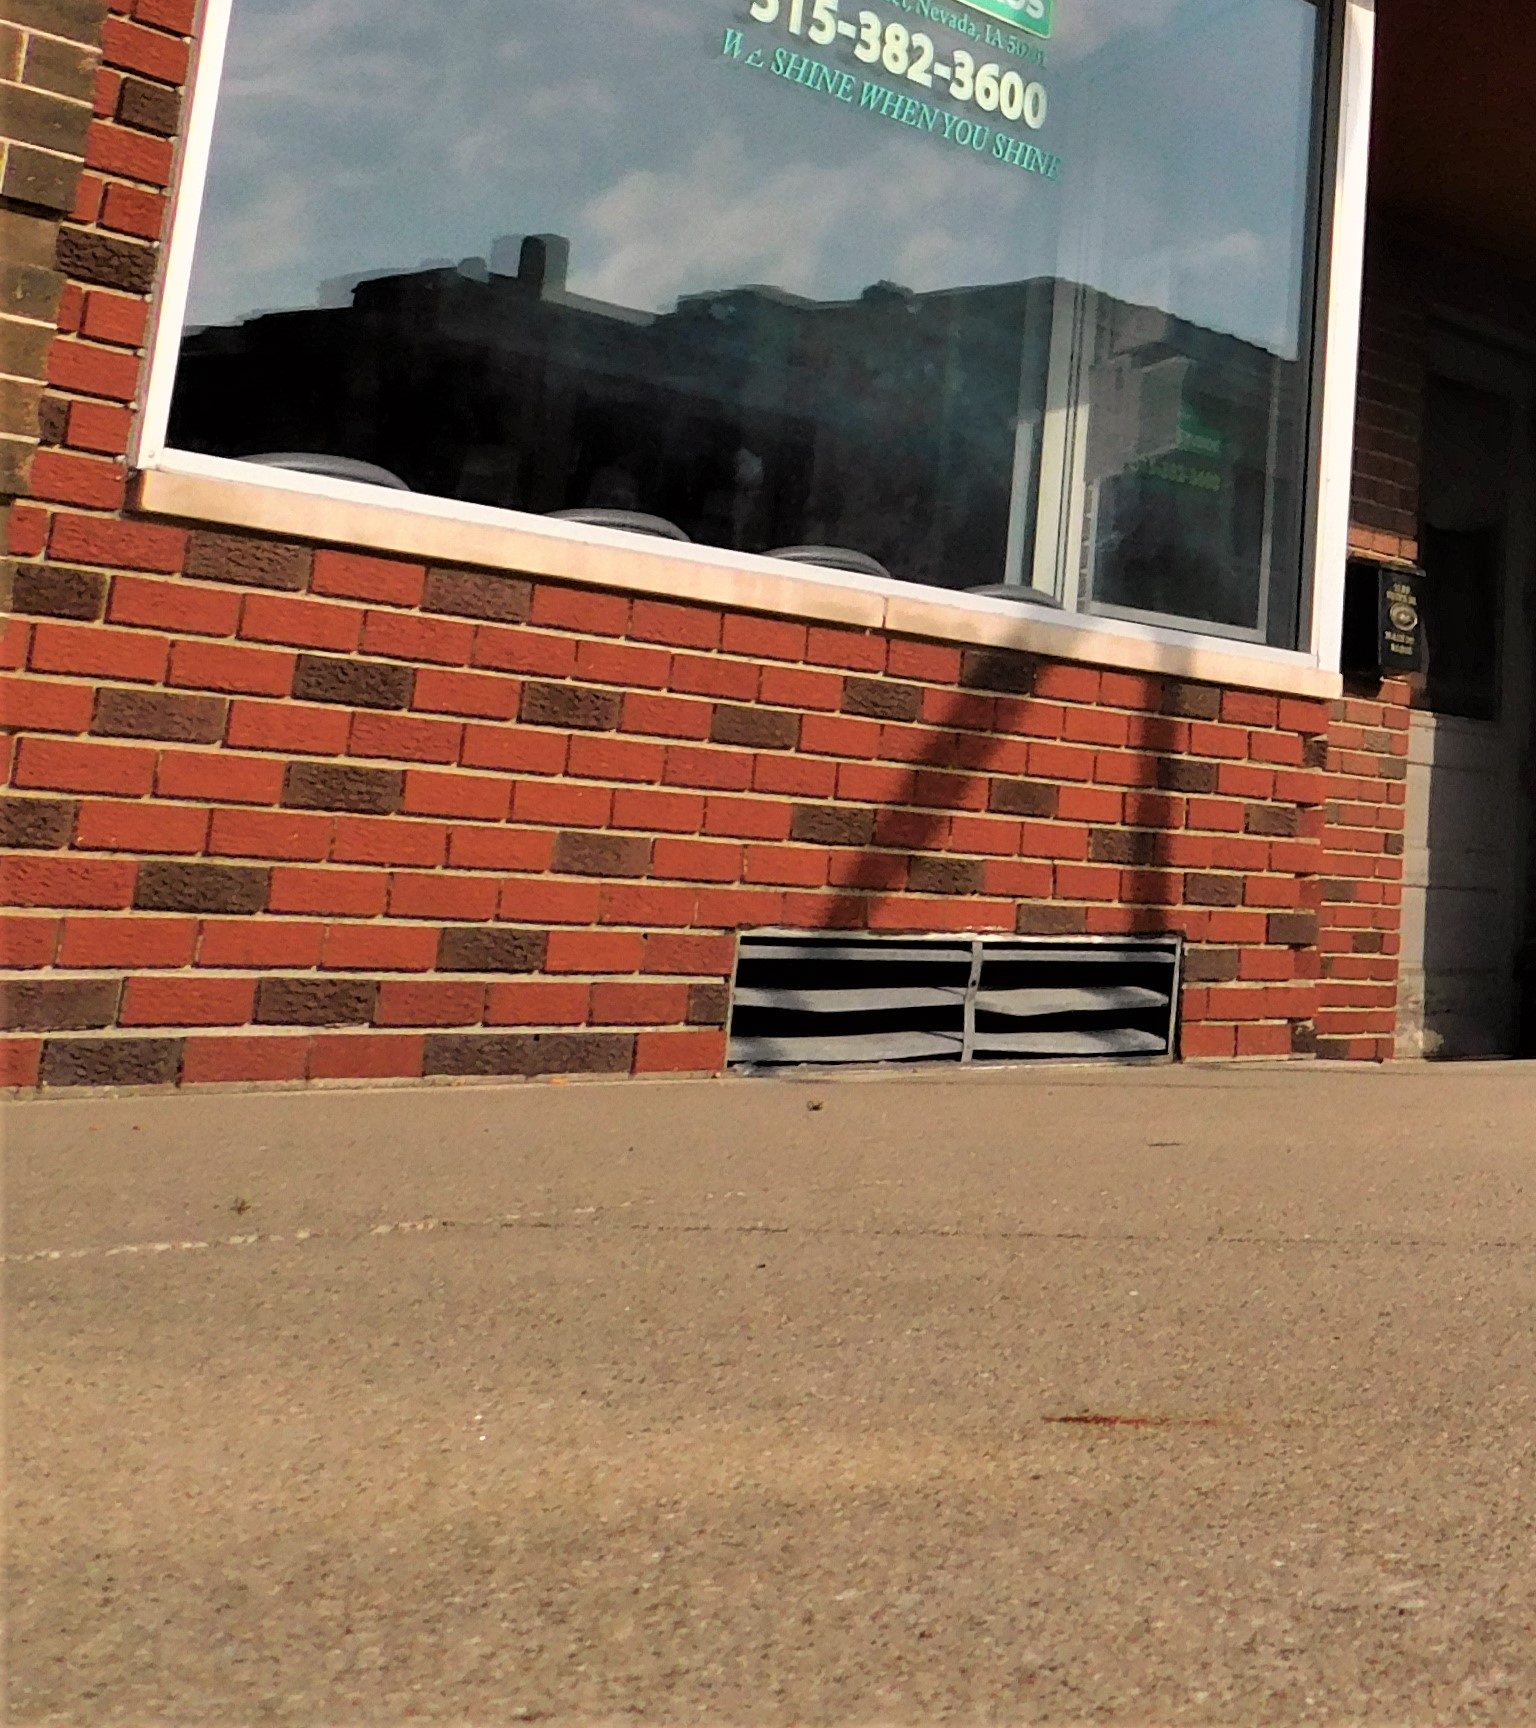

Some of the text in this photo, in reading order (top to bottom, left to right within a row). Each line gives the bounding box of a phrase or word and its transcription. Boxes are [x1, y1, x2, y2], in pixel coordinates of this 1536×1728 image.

[984, 23, 1004, 50] IA
[770, 47, 855, 103] SHINE
[858, 81, 940, 132] WHEN
[942, 112, 989, 152] YOU
[992, 133, 1063, 181] SHINE
